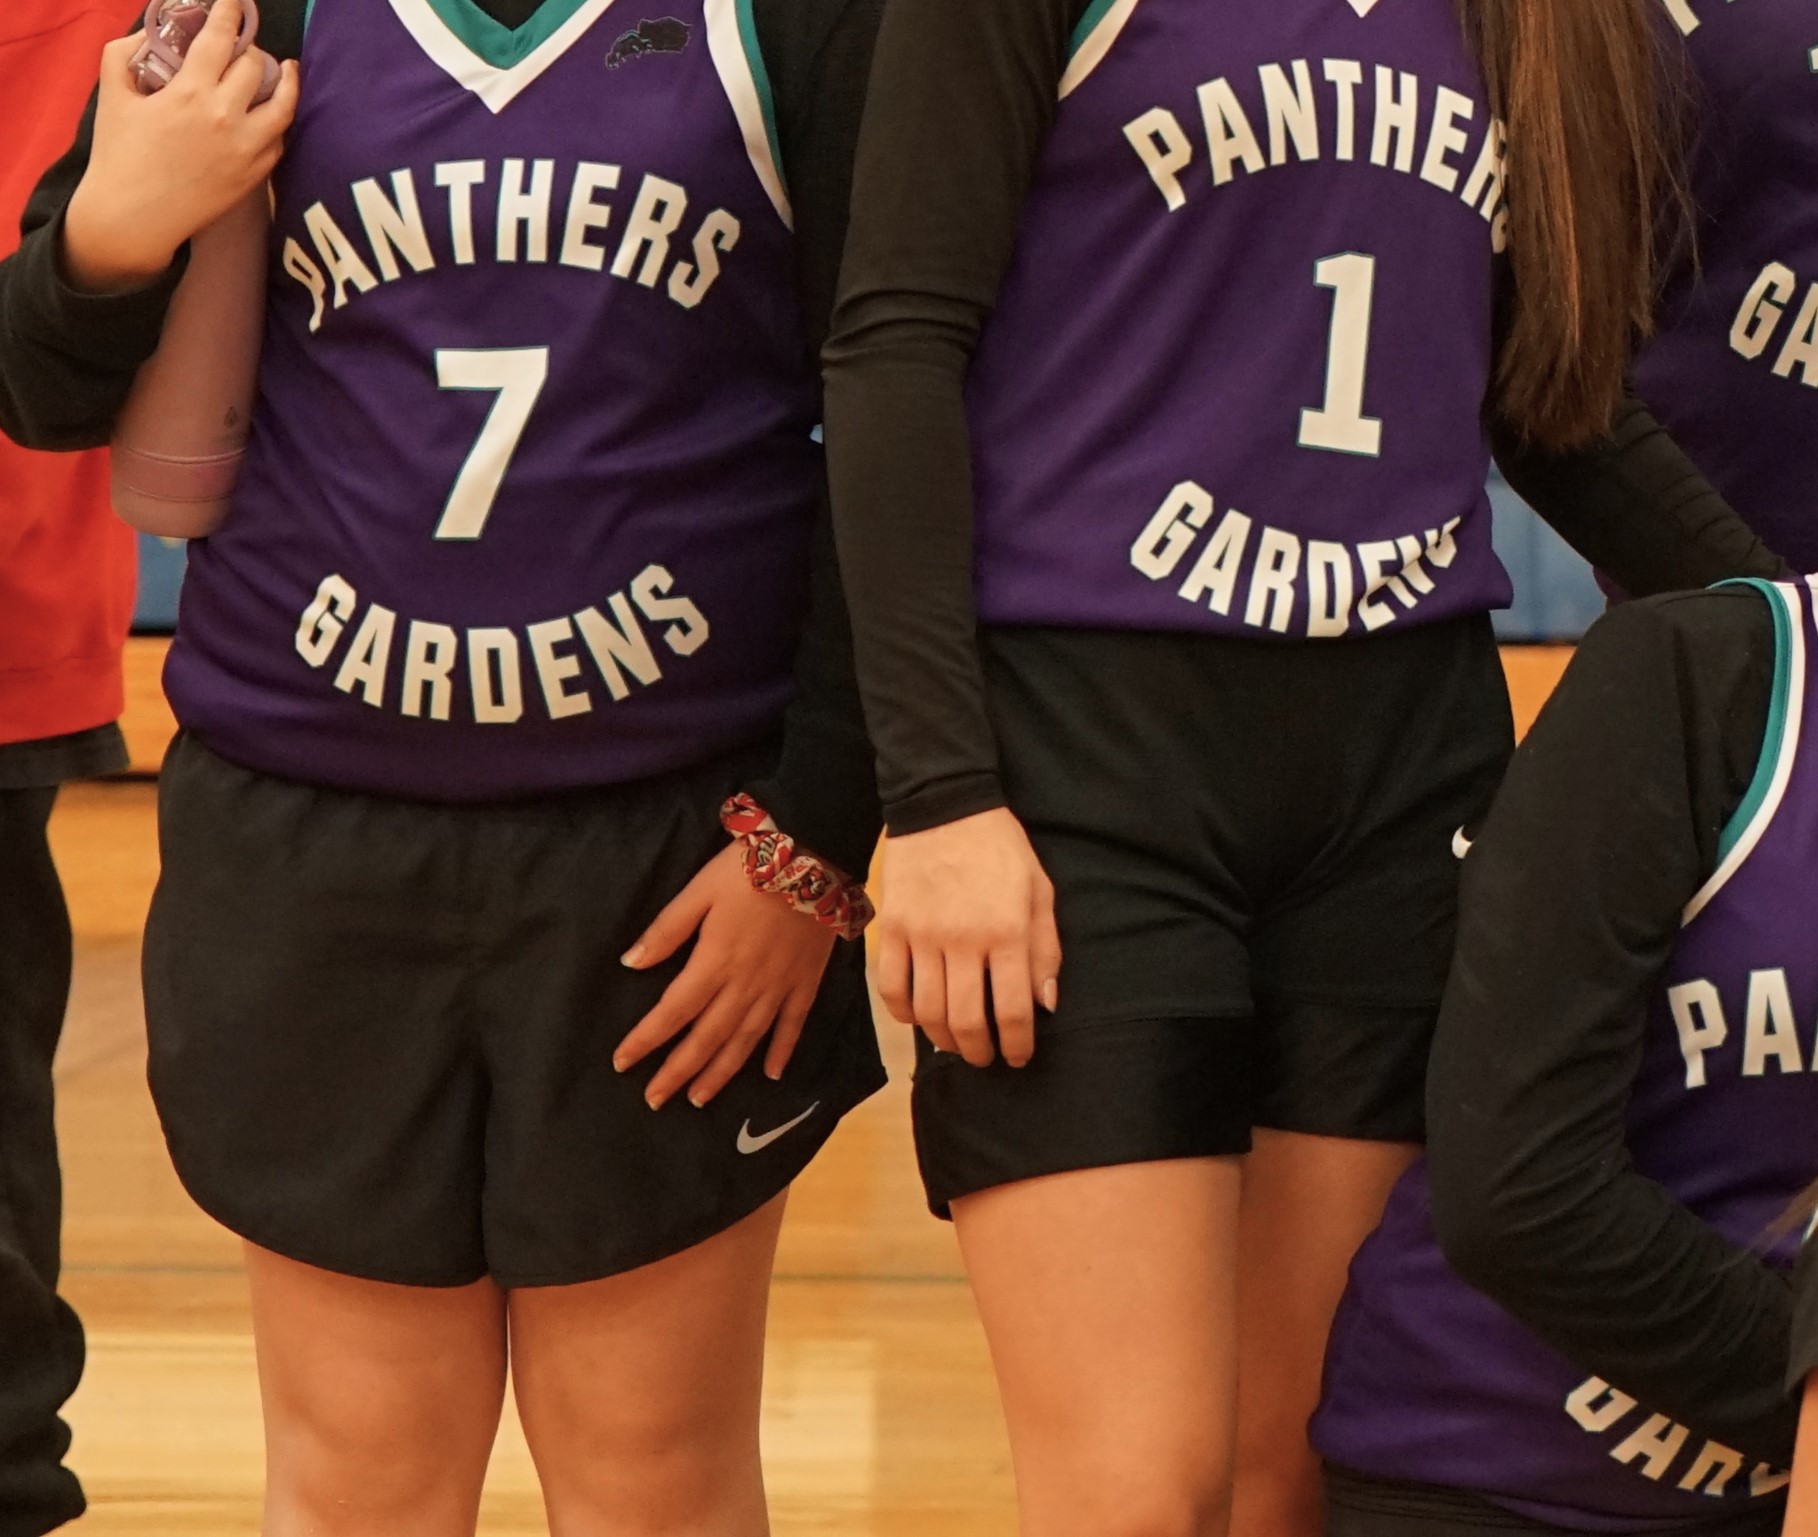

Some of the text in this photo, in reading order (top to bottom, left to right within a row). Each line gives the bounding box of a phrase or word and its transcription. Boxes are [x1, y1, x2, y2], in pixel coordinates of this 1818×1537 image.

[282, 157, 741, 333] PANTHERS
[1122, 57, 1511, 254] PANTHER
[433, 345, 550, 542] 7
[1296, 251, 1383, 458] 1
[295, 561, 710, 725] GARDENS
